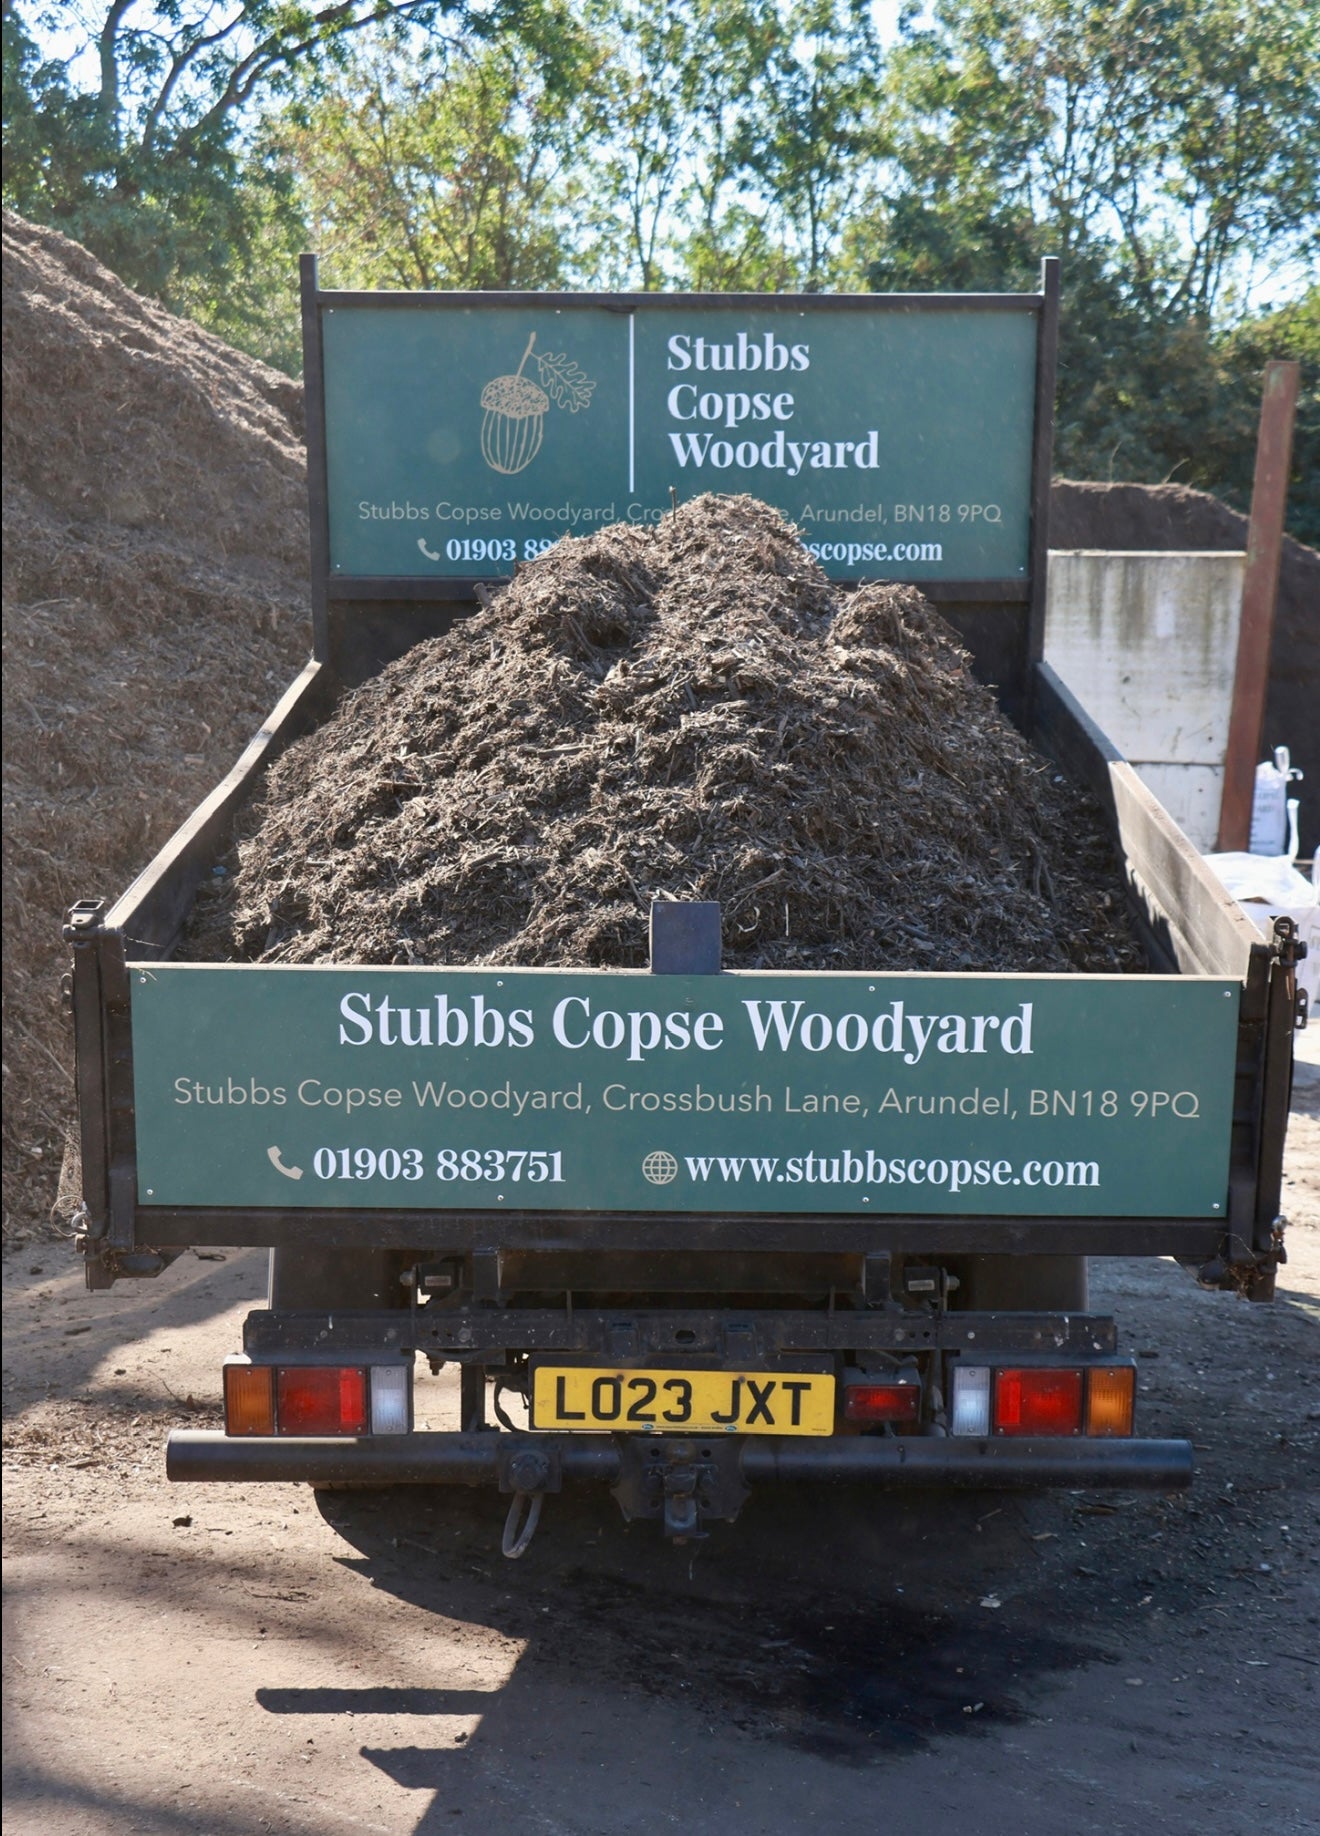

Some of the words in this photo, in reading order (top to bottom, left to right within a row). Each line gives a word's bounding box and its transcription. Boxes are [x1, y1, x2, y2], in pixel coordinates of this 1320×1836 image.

[667, 332, 810, 372] Stubbs
[667, 384, 795, 427] Copse
[669, 430, 880, 475] Woodyard
[358, 501, 430, 520] Stubbs
[435, 502, 502, 525] Copse
[507, 502, 620, 526] Woodyard,
[800, 503, 888, 525] Arundel,
[894, 504, 951, 523] BN18
[957, 504, 1002, 523] 9PQ
[446, 538, 517, 561] 01903
[339, 992, 535, 1048] Stubbs
[552, 996, 724, 1062] Copse
[741, 1000, 1034, 1065] Woodyard
[174, 1076, 287, 1105] Stubbs
[297, 1079, 402, 1114] Copse
[412, 1080, 591, 1117] Woodyard,
[602, 1083, 772, 1112] Crossbush
[785, 1086, 869, 1118] Lane,
[878, 1087, 1017, 1120] Arundel,
[1029, 1090, 1118, 1117] BN18
[1130, 1090, 1200, 1118] 9PQ
[313, 1147, 424, 1181] 01903
[436, 1149, 566, 1183] 883751
[684, 1149, 1100, 1193] www.stubbscopse.com
[556, 1376, 692, 1422] LO23
[711, 1380, 811, 1426] JXT
